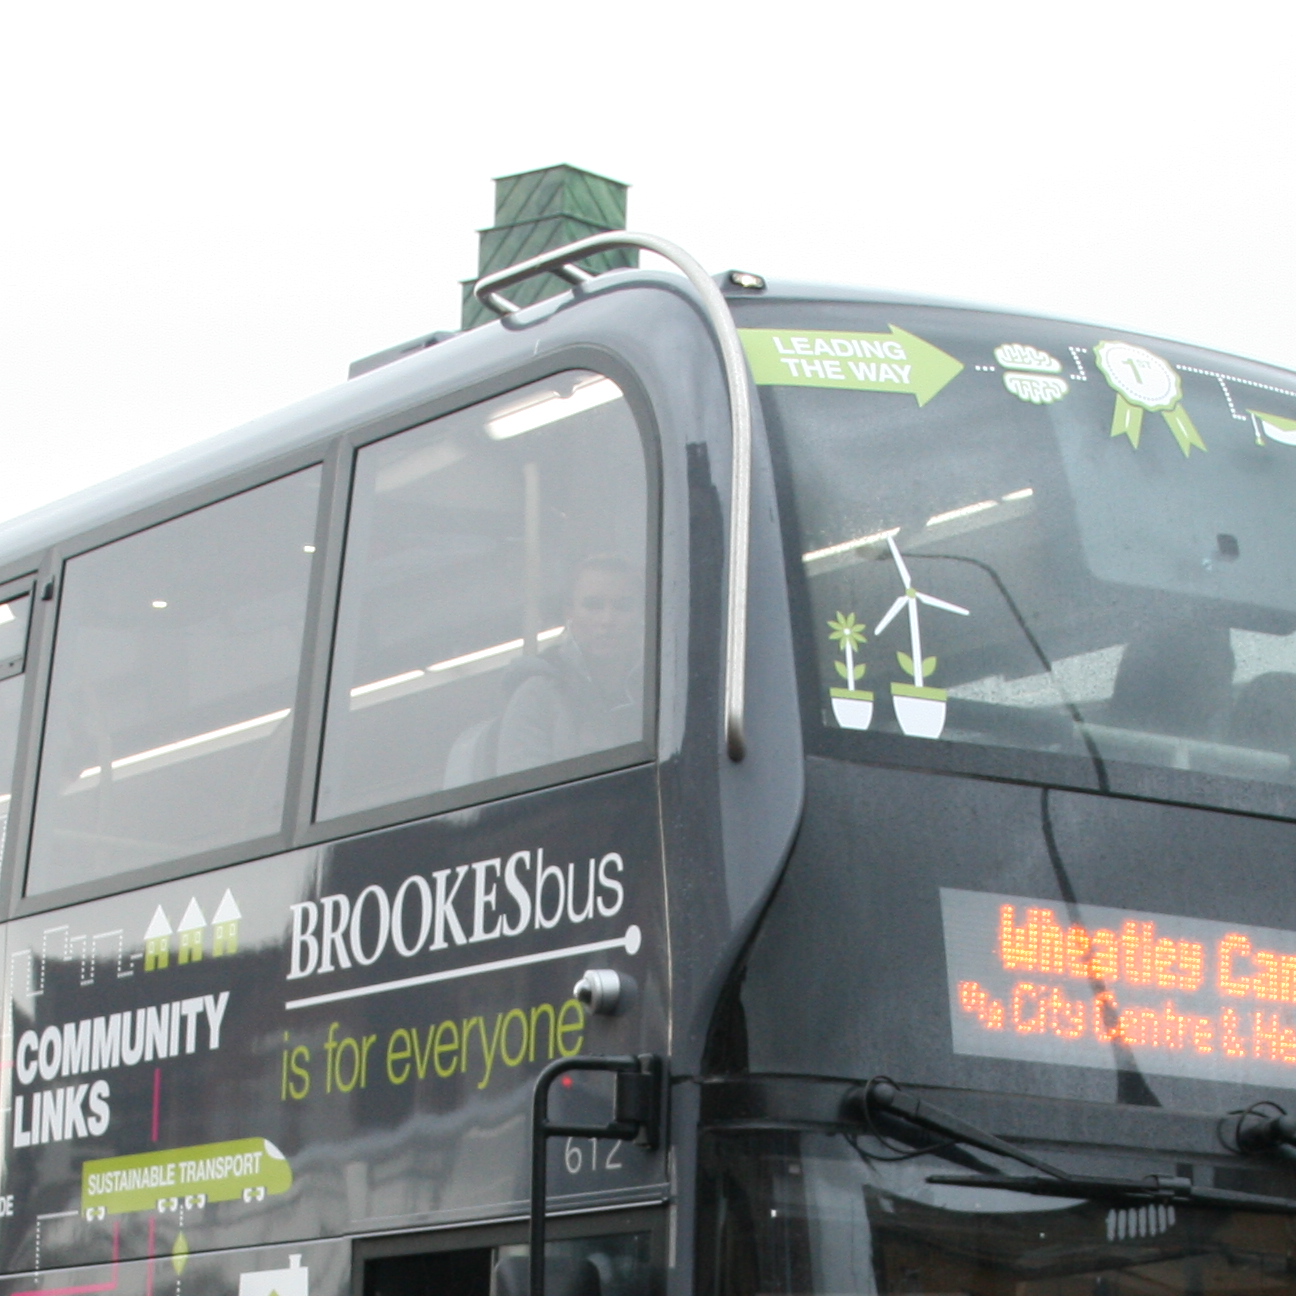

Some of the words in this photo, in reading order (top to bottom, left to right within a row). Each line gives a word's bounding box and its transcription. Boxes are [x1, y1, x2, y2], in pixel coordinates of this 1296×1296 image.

[772, 335, 908, 361] LEADING
[781, 357, 845, 381] THE
[848, 361, 912, 385] WAY
[1000, 902, 1203, 991] Wheatley
[16, 990, 231, 1085] COMMUNITY
[281, 1032, 311, 1100] is
[324, 1021, 377, 1094] for
[386, 998, 586, 1089] everyone
[1012, 981, 1086, 1041] City
[1094, 990, 1214, 1054] Centre
[1220, 1006, 1246, 1058] &
[13, 1079, 111, 1149] LINKS
[87, 1163, 176, 1196] SUSTAINABLE
[178, 1152, 263, 1183] TRANSPORT
